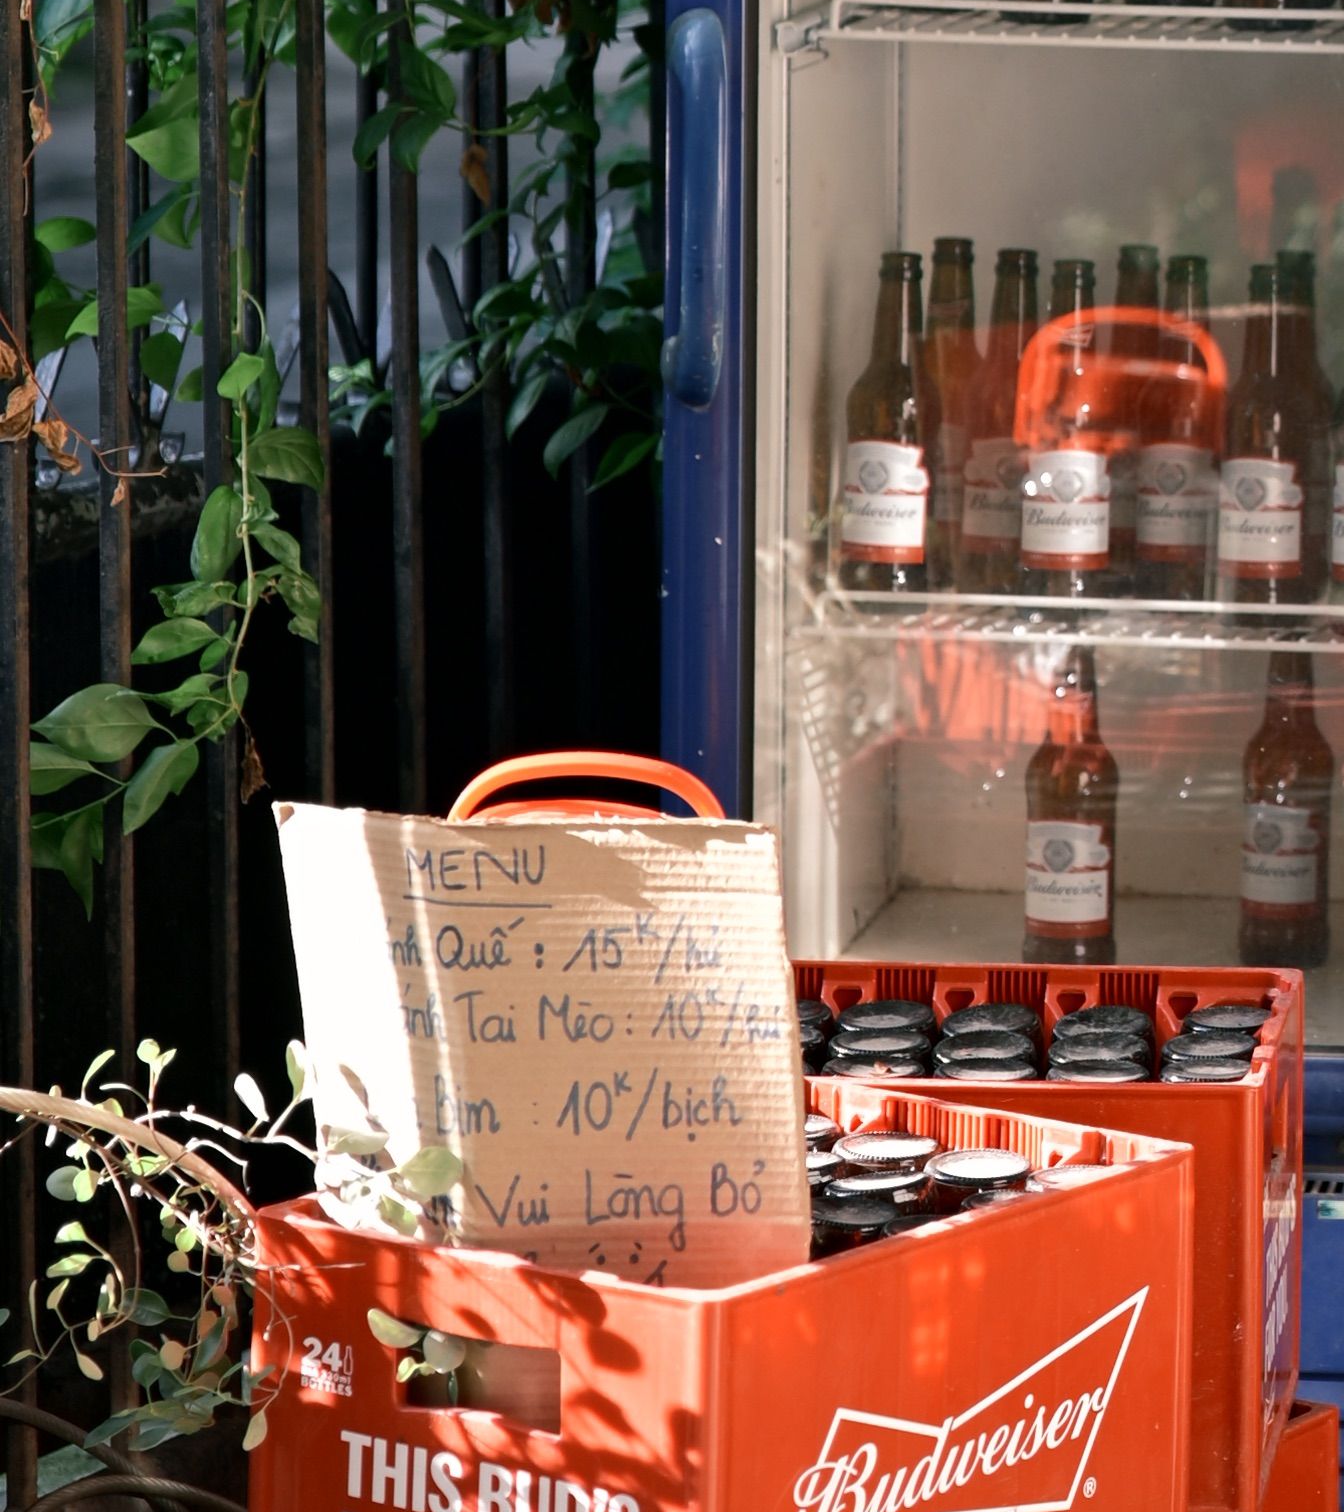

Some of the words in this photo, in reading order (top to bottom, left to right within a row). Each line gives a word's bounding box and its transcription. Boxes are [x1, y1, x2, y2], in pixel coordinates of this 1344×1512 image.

[405, 845, 546, 891] MENU
[436, 916, 526, 972] Quế
[453, 990, 518, 1044] Tai
[475, 1175, 550, 1227] Vui
[709, 1158, 767, 1216] Bỏ
[301, 1336, 342, 1372] 24
[300, 1375, 353, 1398] BOTTLES
